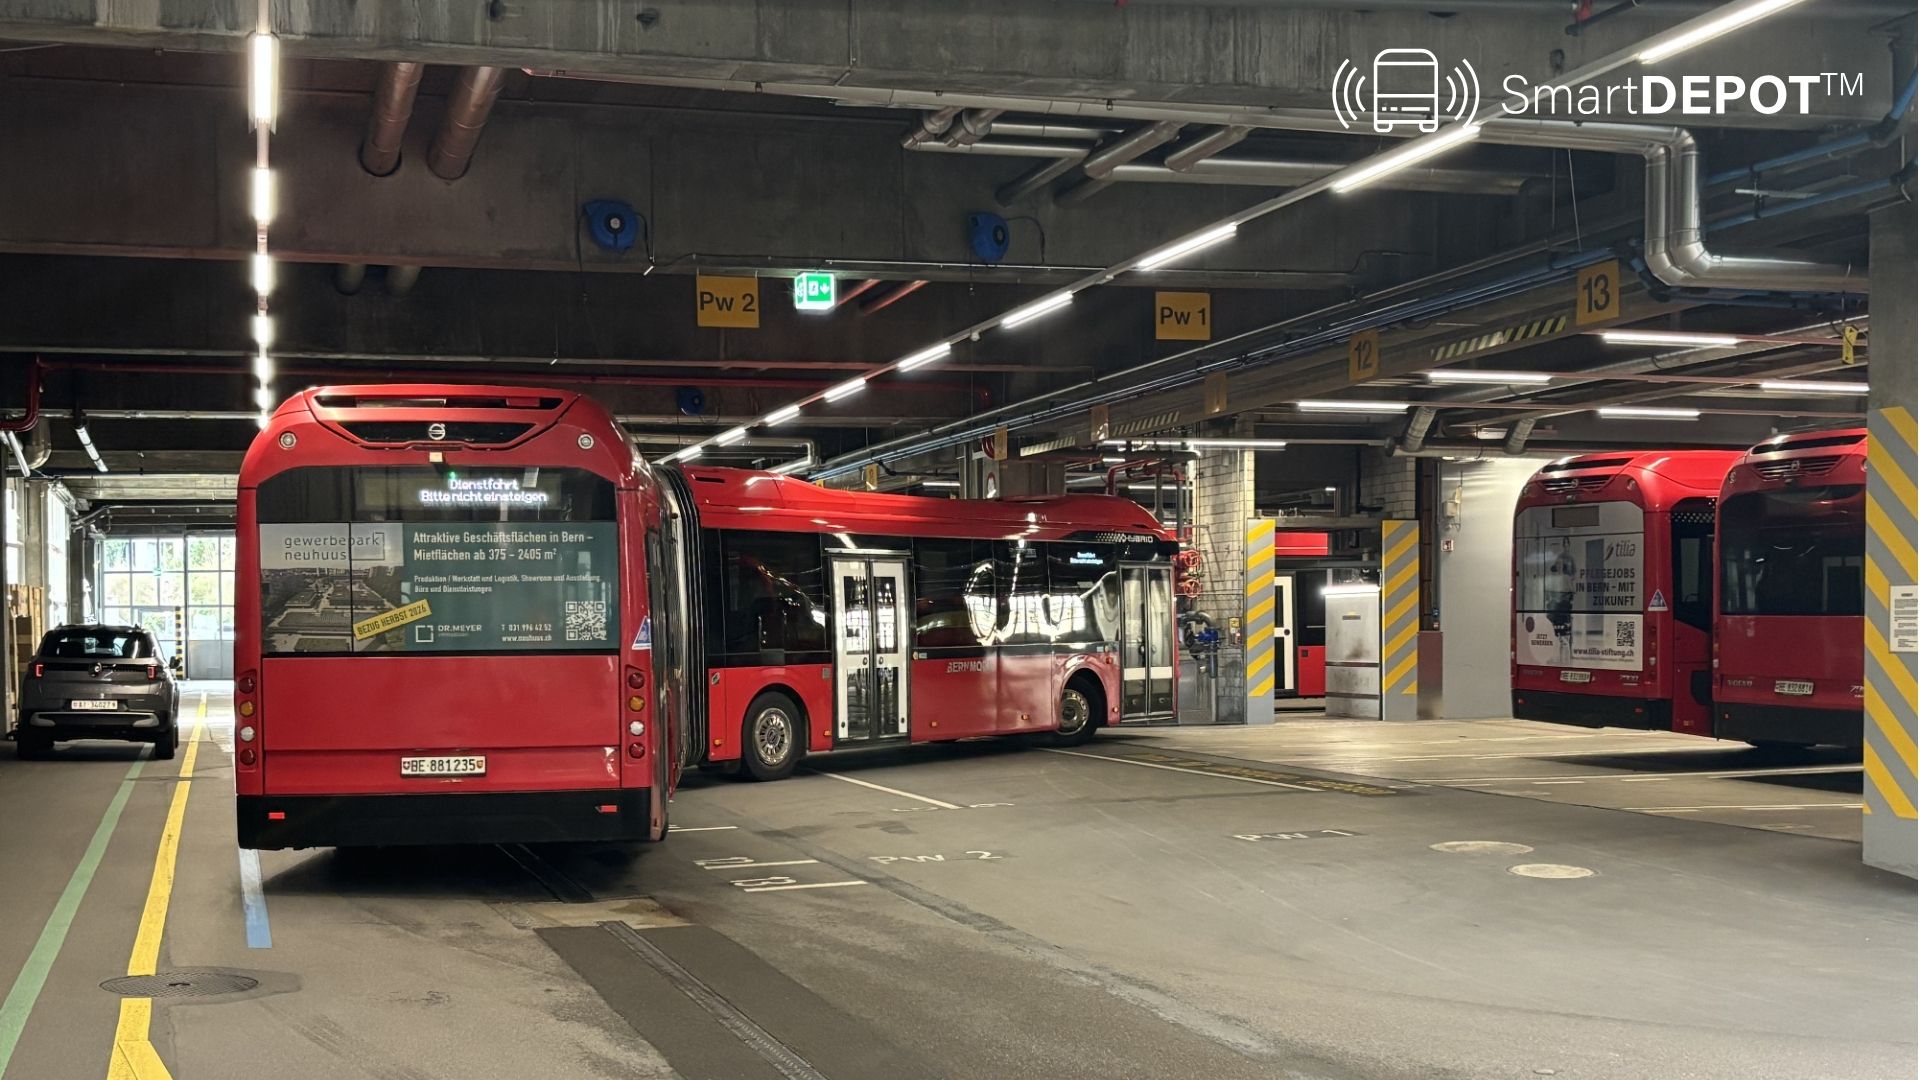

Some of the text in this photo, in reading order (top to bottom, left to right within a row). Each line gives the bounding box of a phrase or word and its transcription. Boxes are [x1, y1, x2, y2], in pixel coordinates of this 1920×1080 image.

[1582, 274, 1611, 313] 13
[700, 292, 755, 312] Pw 2
[1160, 307, 1206, 325] Pw 1
[1354, 339, 1373, 372] 12
[450, 478, 518, 490] Dienstfahrt
[421, 490, 547, 503] Bitte nicht einsteigen
[284, 531, 380, 549] gewerbepark
[413, 531, 460, 543] Attraktive
[463, 531, 547, 543] Geschäftsflächen
[549, 532, 559, 542] in
[561, 532, 584, 542] Bern
[285, 549, 347, 560] neuhuus
[413, 549, 471, 561] Mietflächen
[473, 549, 486, 560] ab
[489, 549, 507, 560] 375
[518, 549, 542, 560] 2405
[1616, 540, 1635, 557] tilia
[1576, 583, 1585, 592] IN
[1587, 582, 1610, 592] BERN
[1618, 582, 1635, 592] MIT
[1593, 596, 1635, 606] ZUKUNFT
[357, 604, 427, 635] BEZUG HERBST 2026
